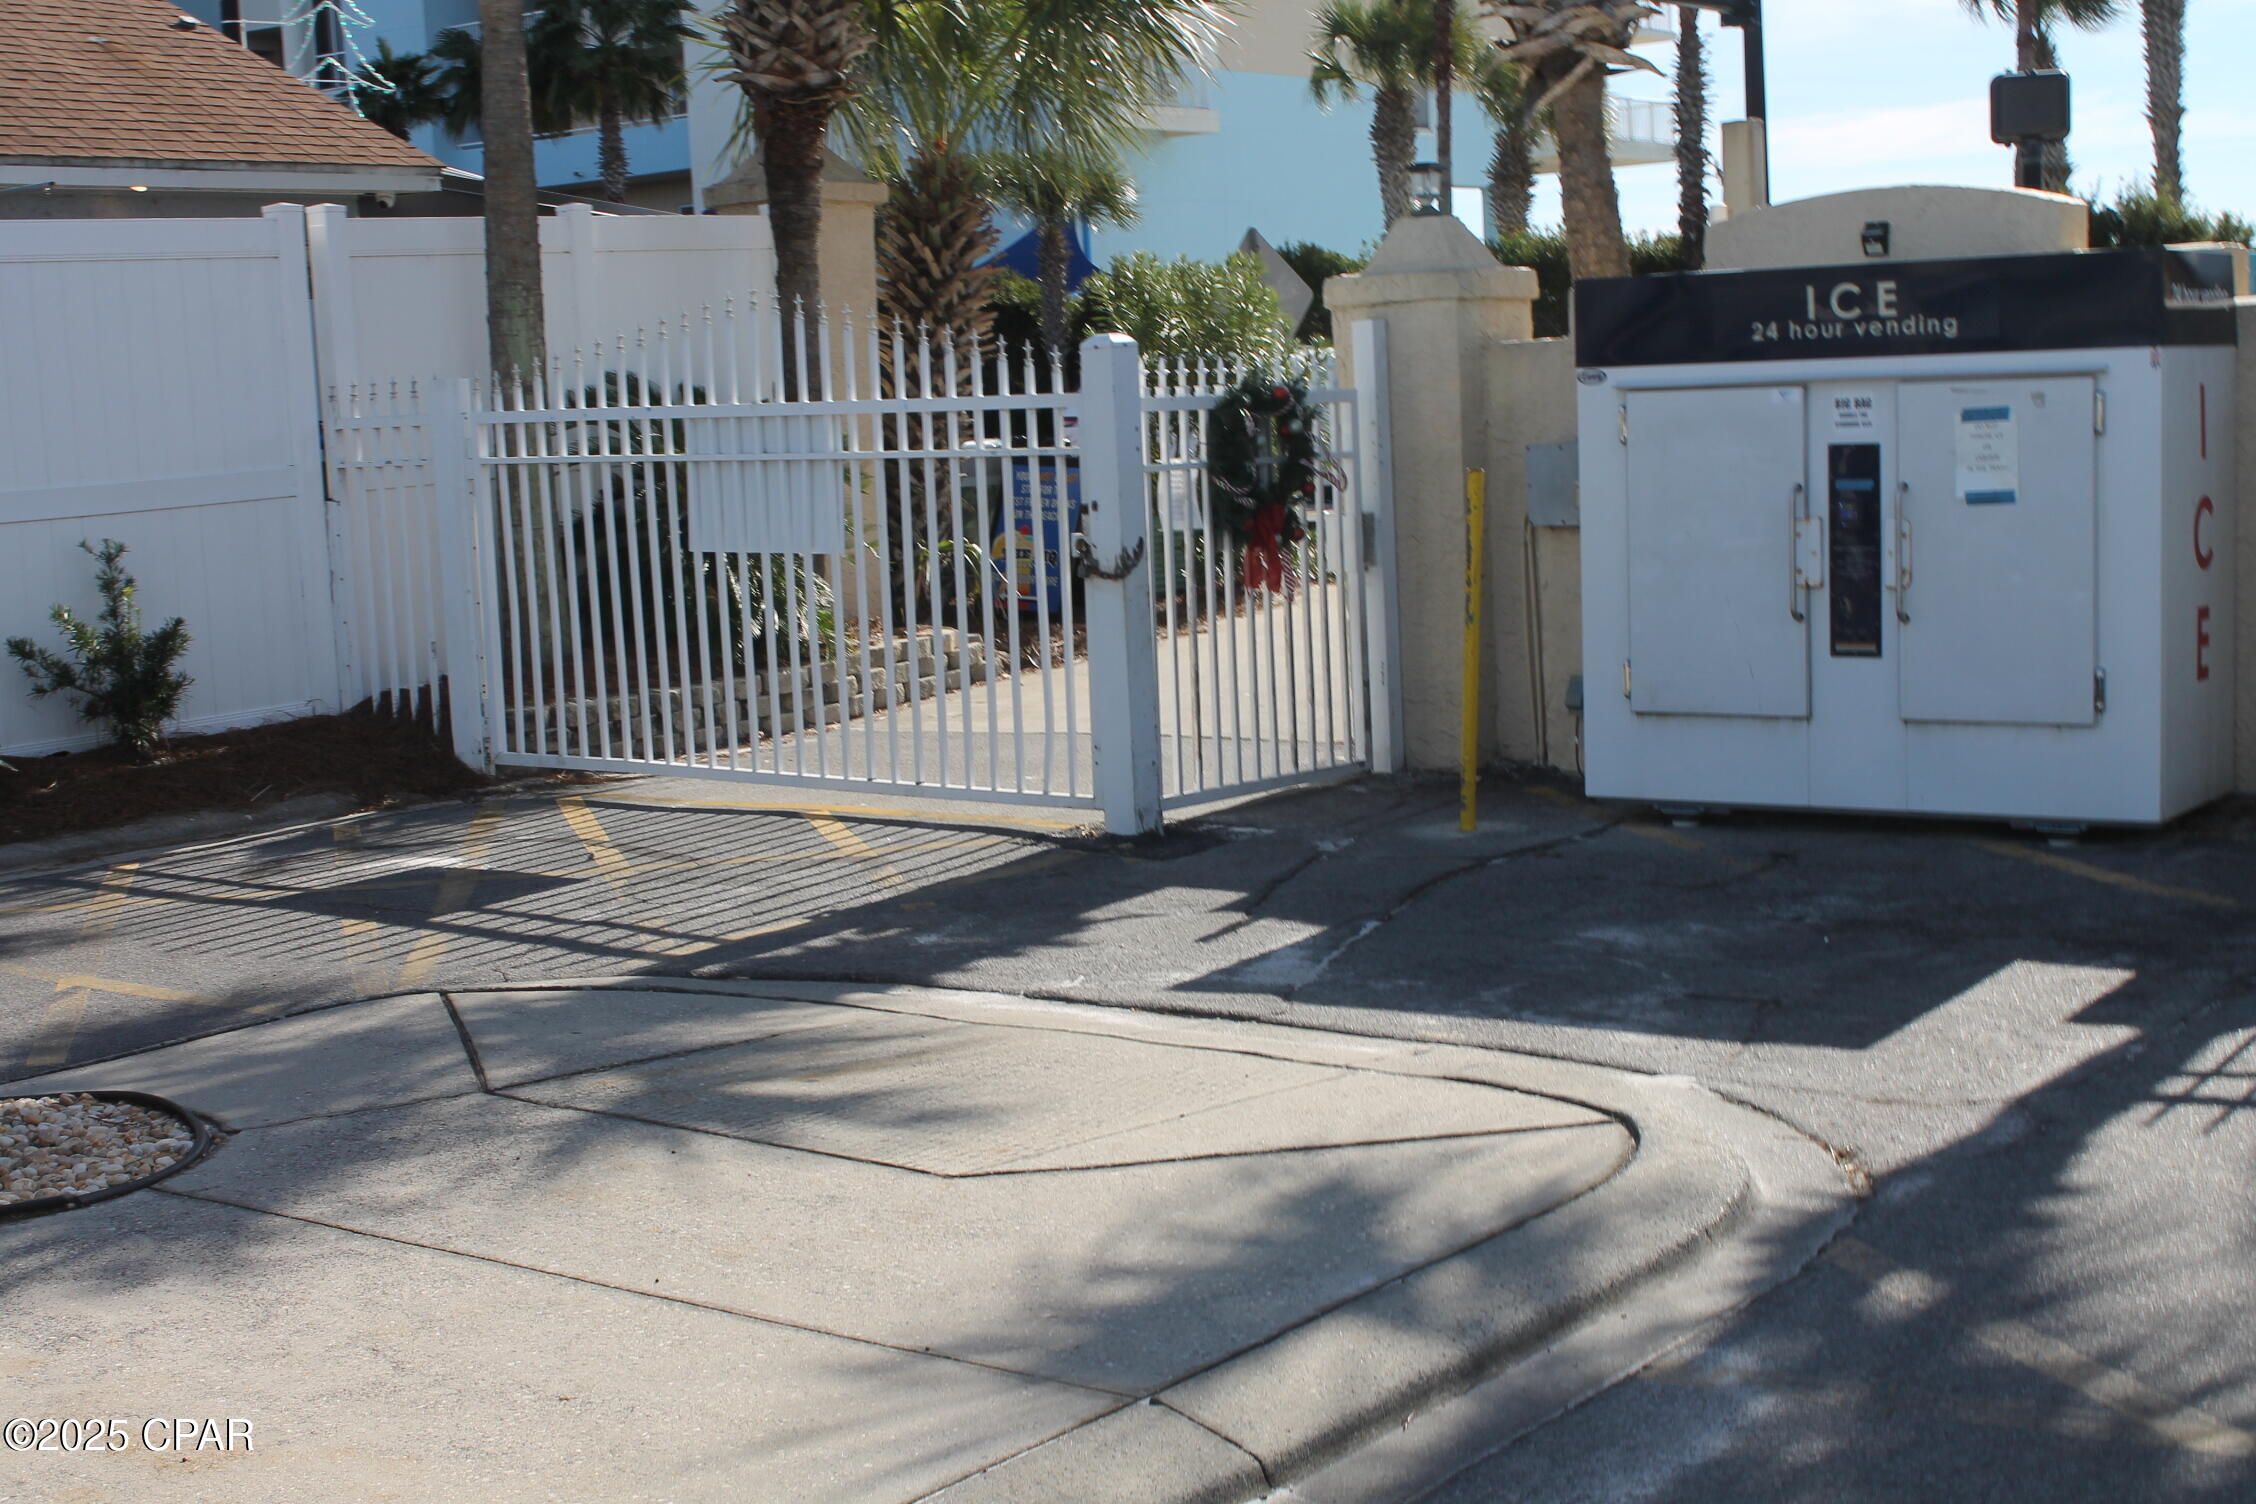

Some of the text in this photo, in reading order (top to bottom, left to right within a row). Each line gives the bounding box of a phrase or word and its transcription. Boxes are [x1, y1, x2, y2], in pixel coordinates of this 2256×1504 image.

[1805, 280, 1899, 321] ICE
[1751, 313, 1960, 342] 24 hour vending
